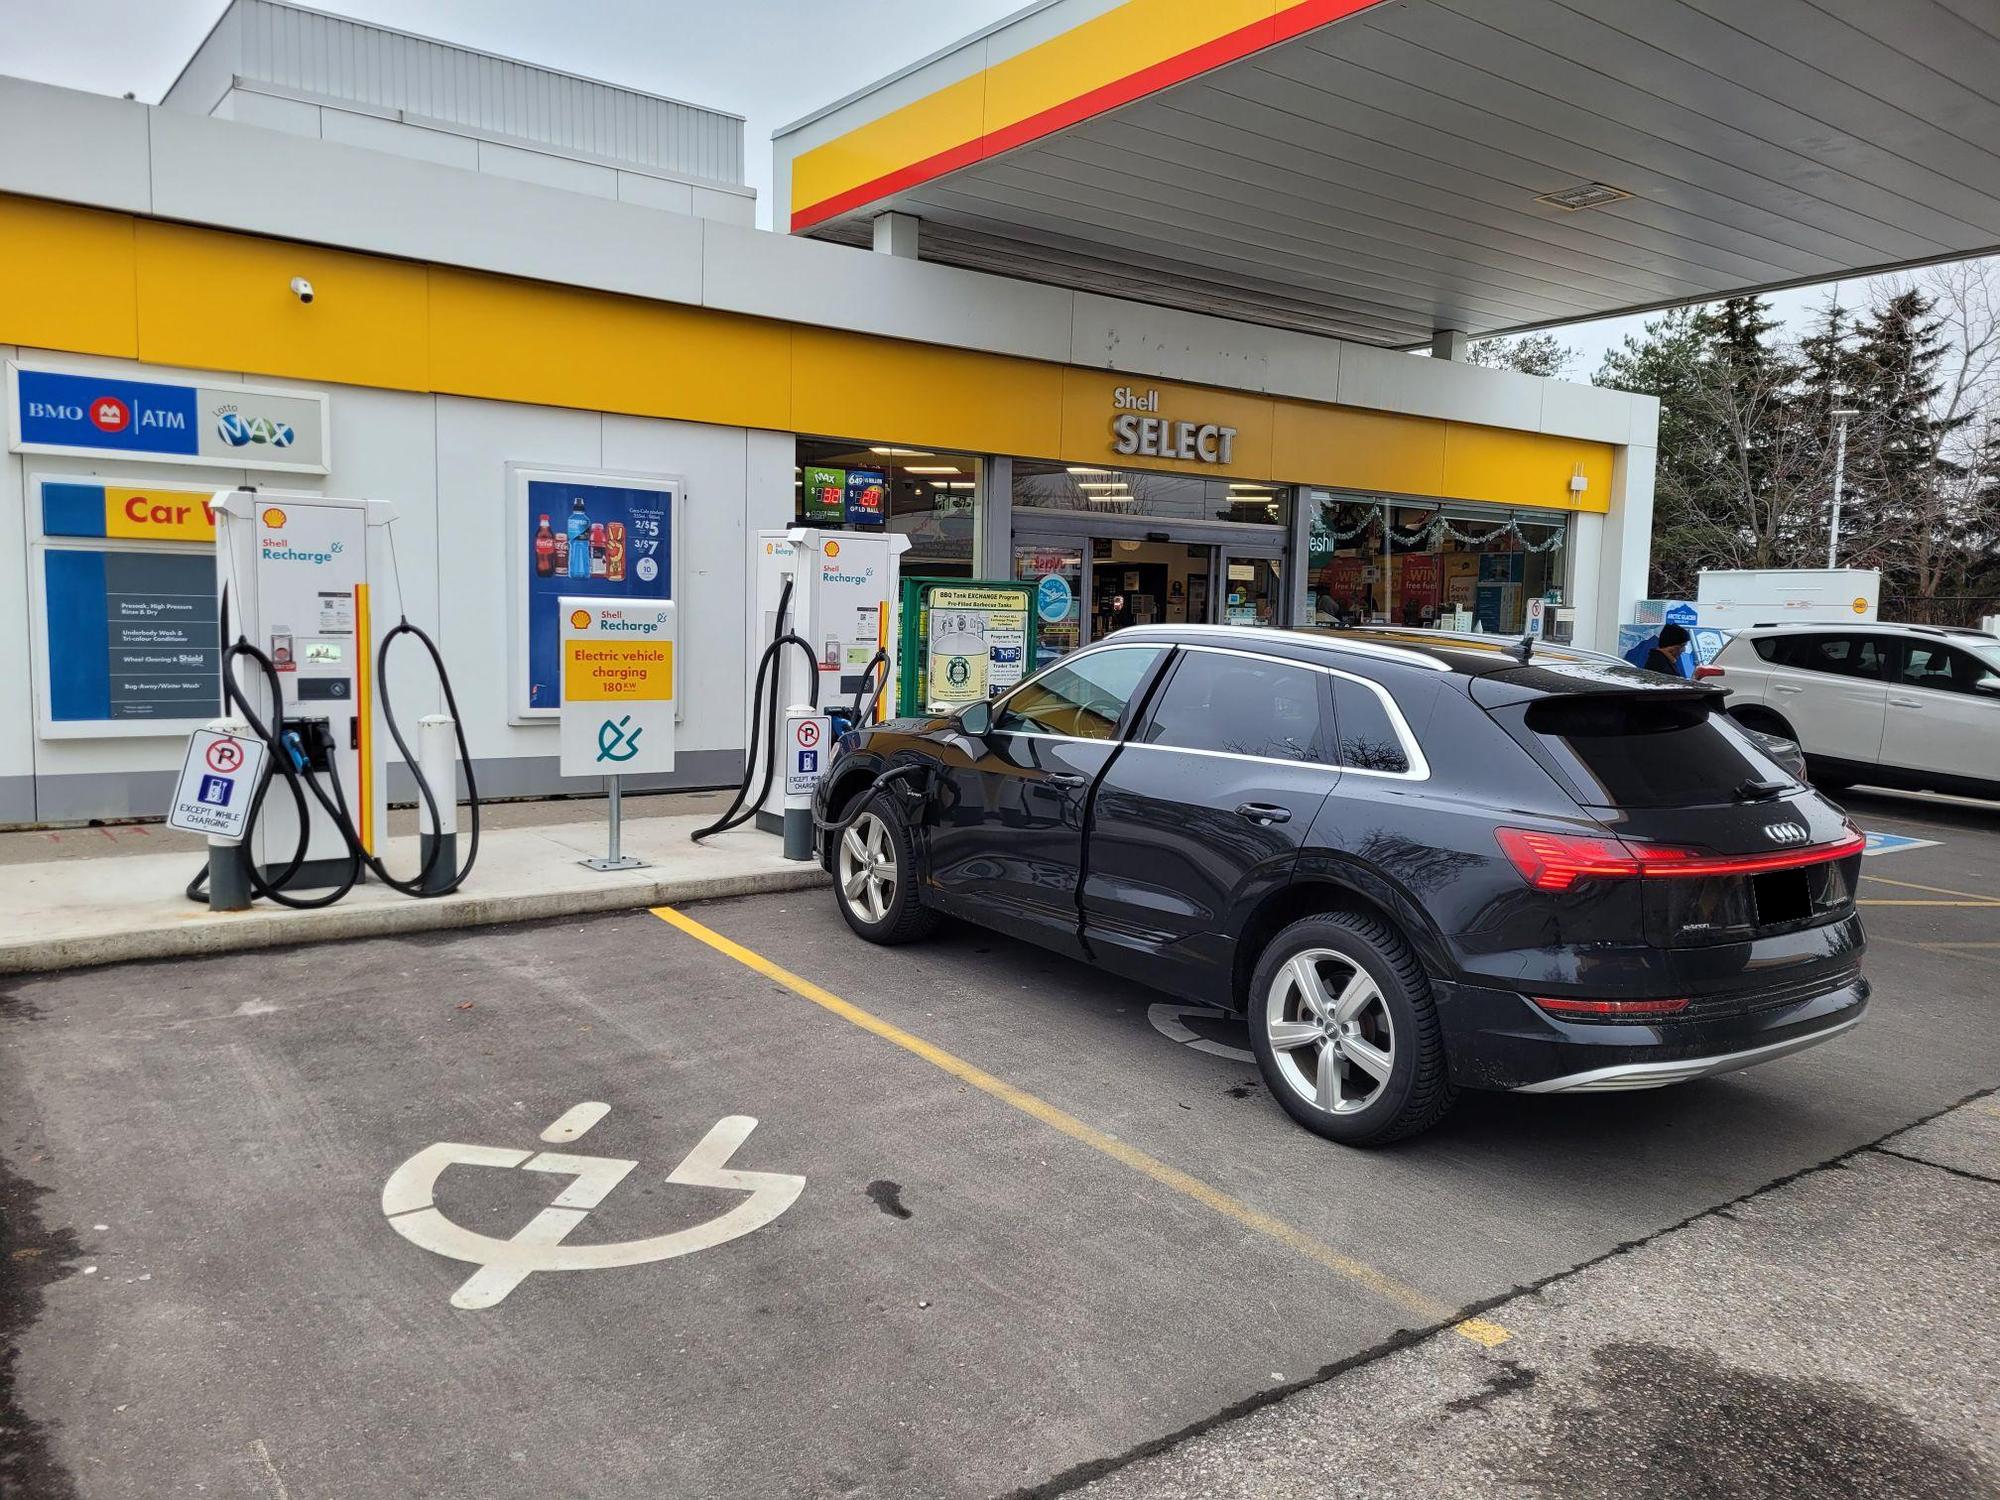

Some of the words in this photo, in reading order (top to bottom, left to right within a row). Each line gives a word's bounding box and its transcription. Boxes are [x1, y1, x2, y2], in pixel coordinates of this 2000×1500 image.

[1113, 387, 1159, 412] Shell
[28, 403, 83, 421] BMO
[142, 409, 185, 430] ATM
[212, 404, 238, 417] Lotto
[217, 413, 294, 447] MAX
[1114, 415, 1237, 464] SELECT
[814, 473, 835, 484] MAX
[125, 496, 192, 525] Car
[263, 538, 288, 547] Shell
[1309, 532, 1335, 552] eshii
[262, 548, 332, 564] Recharge
[823, 572, 866, 585] Recharge
[1410, 569, 1437, 582] WIN
[1406, 582, 1421, 590] free
[967, 592, 998, 600] EXCHANGE
[601, 610, 622, 619] Shell
[600, 619, 658, 634] Recharge
[179, 654, 204, 663] Shield
[575, 649, 619, 661] Electric
[622, 649, 665, 661] vehicle
[592, 666, 647, 680] charging
[603, 682, 623, 692] 180
[180, 803, 212, 815] EXCEPT
[215, 810, 240, 822] WHILE
[186, 814, 229, 829] CHARGING
